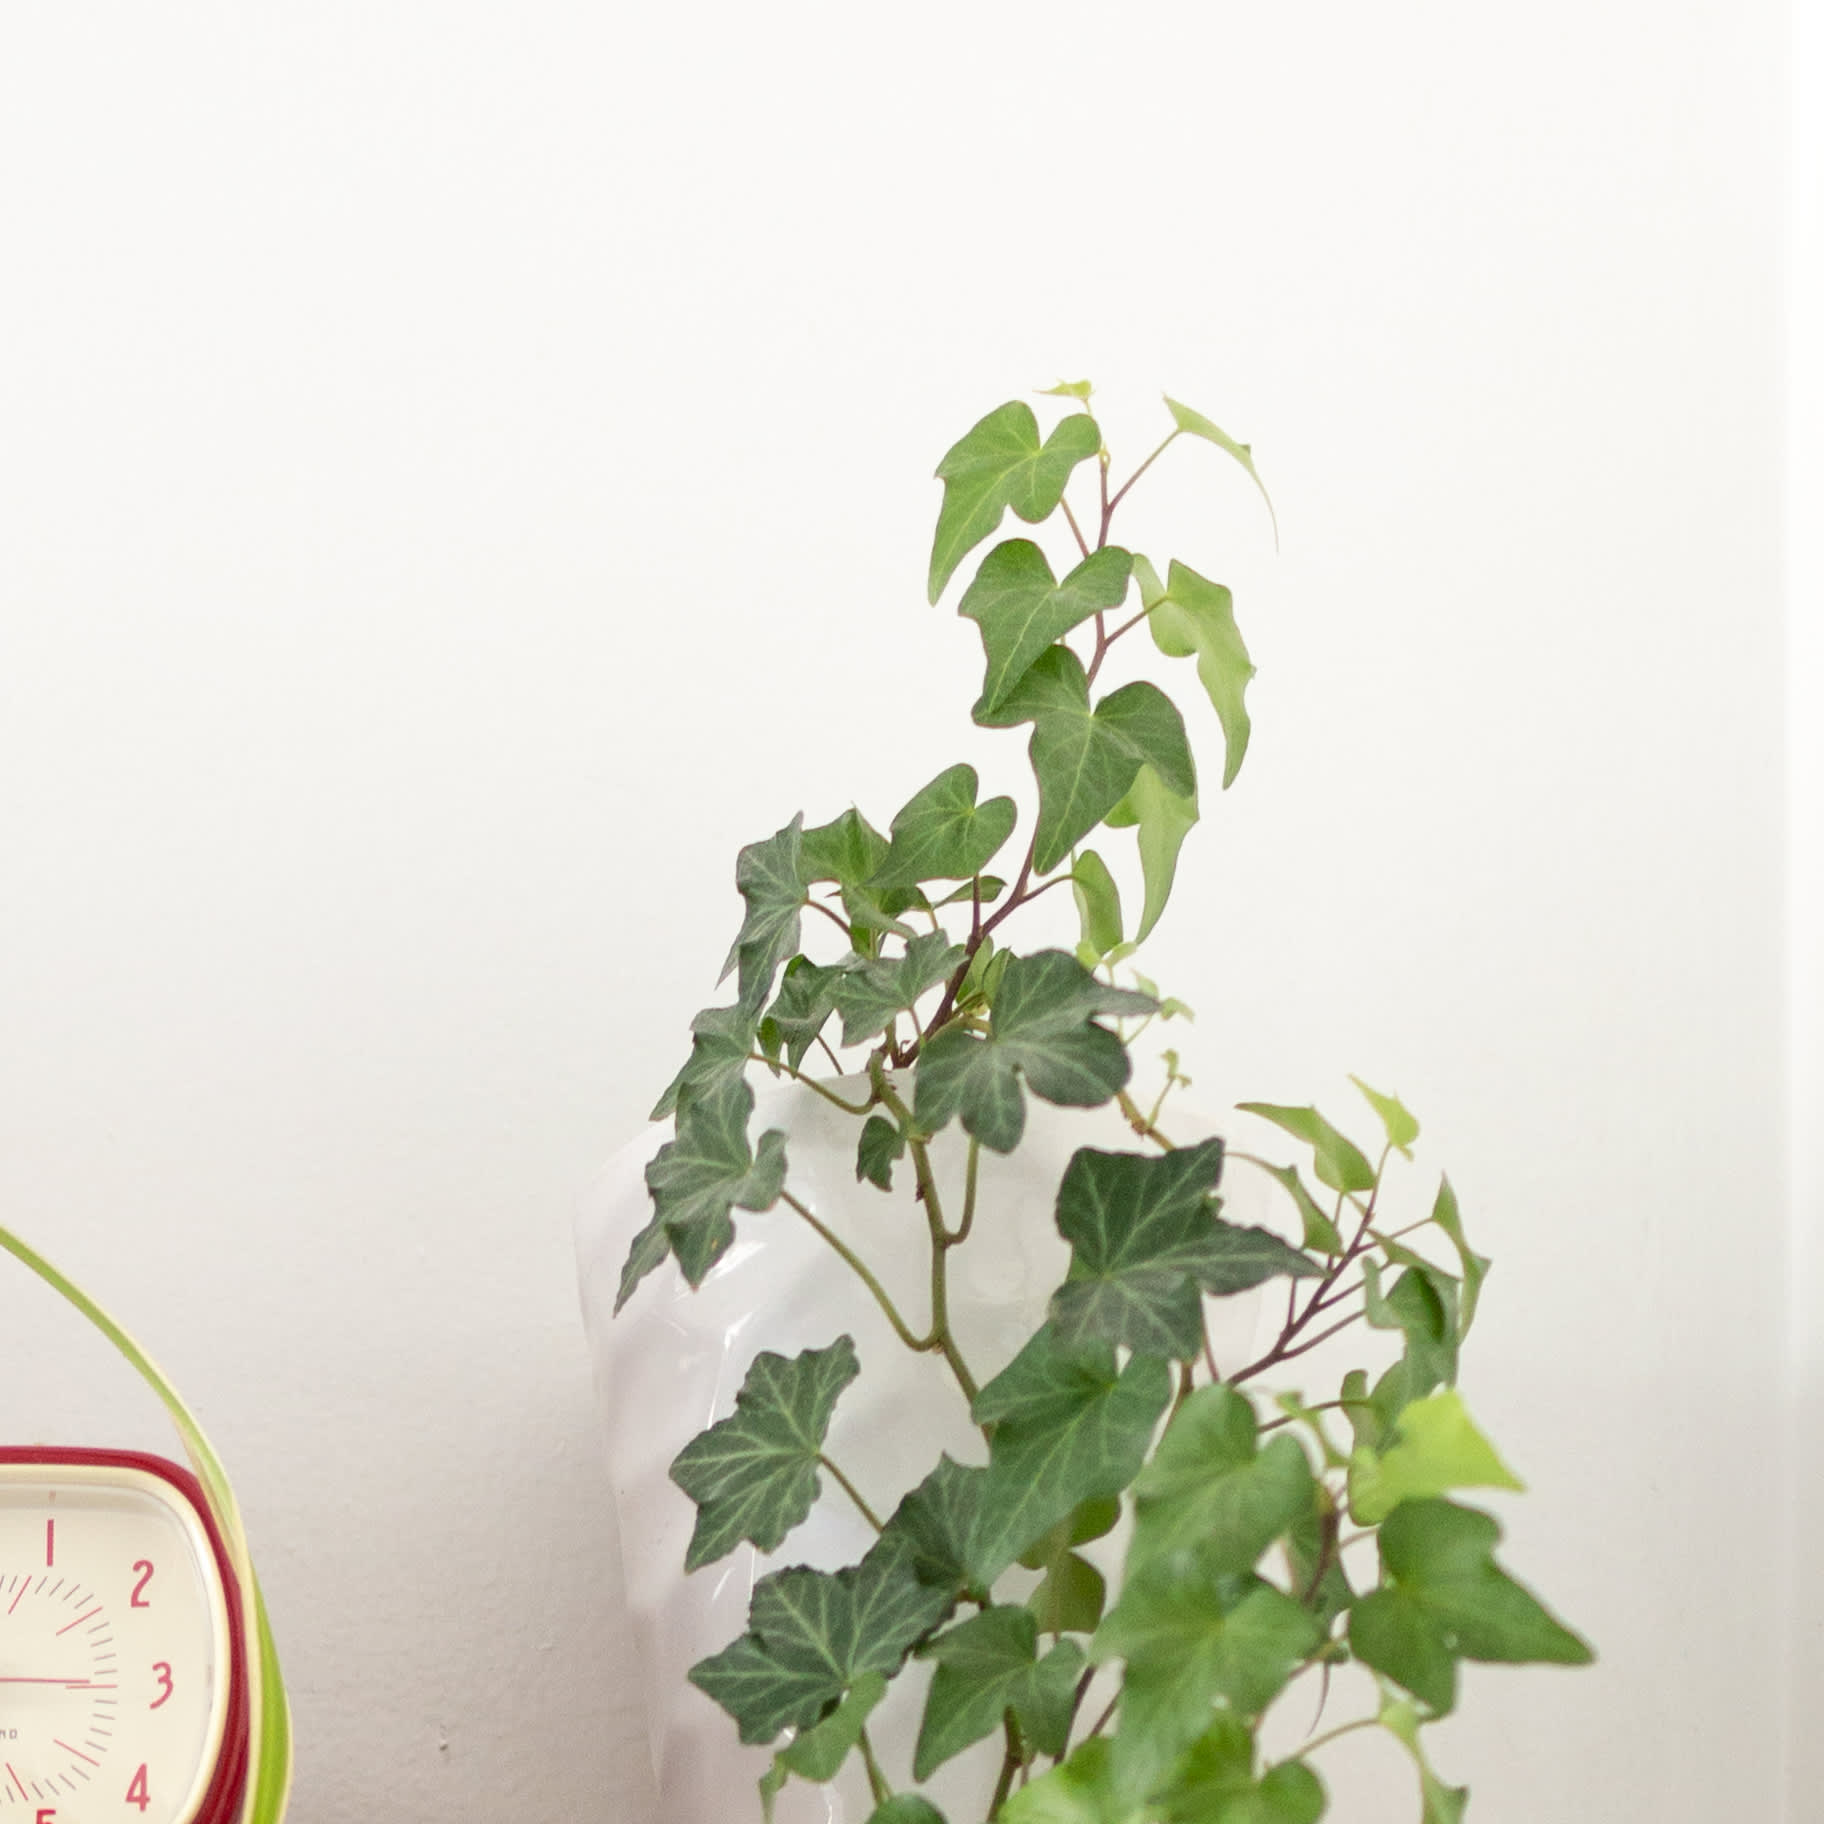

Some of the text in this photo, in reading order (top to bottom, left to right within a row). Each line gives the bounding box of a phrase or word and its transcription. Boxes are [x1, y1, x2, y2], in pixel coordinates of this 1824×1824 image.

[46, 1518, 55, 1567] 1
[130, 1559, 155, 1609] 2
[149, 1660, 174, 1710] 3
[125, 1762, 151, 1812] 4
